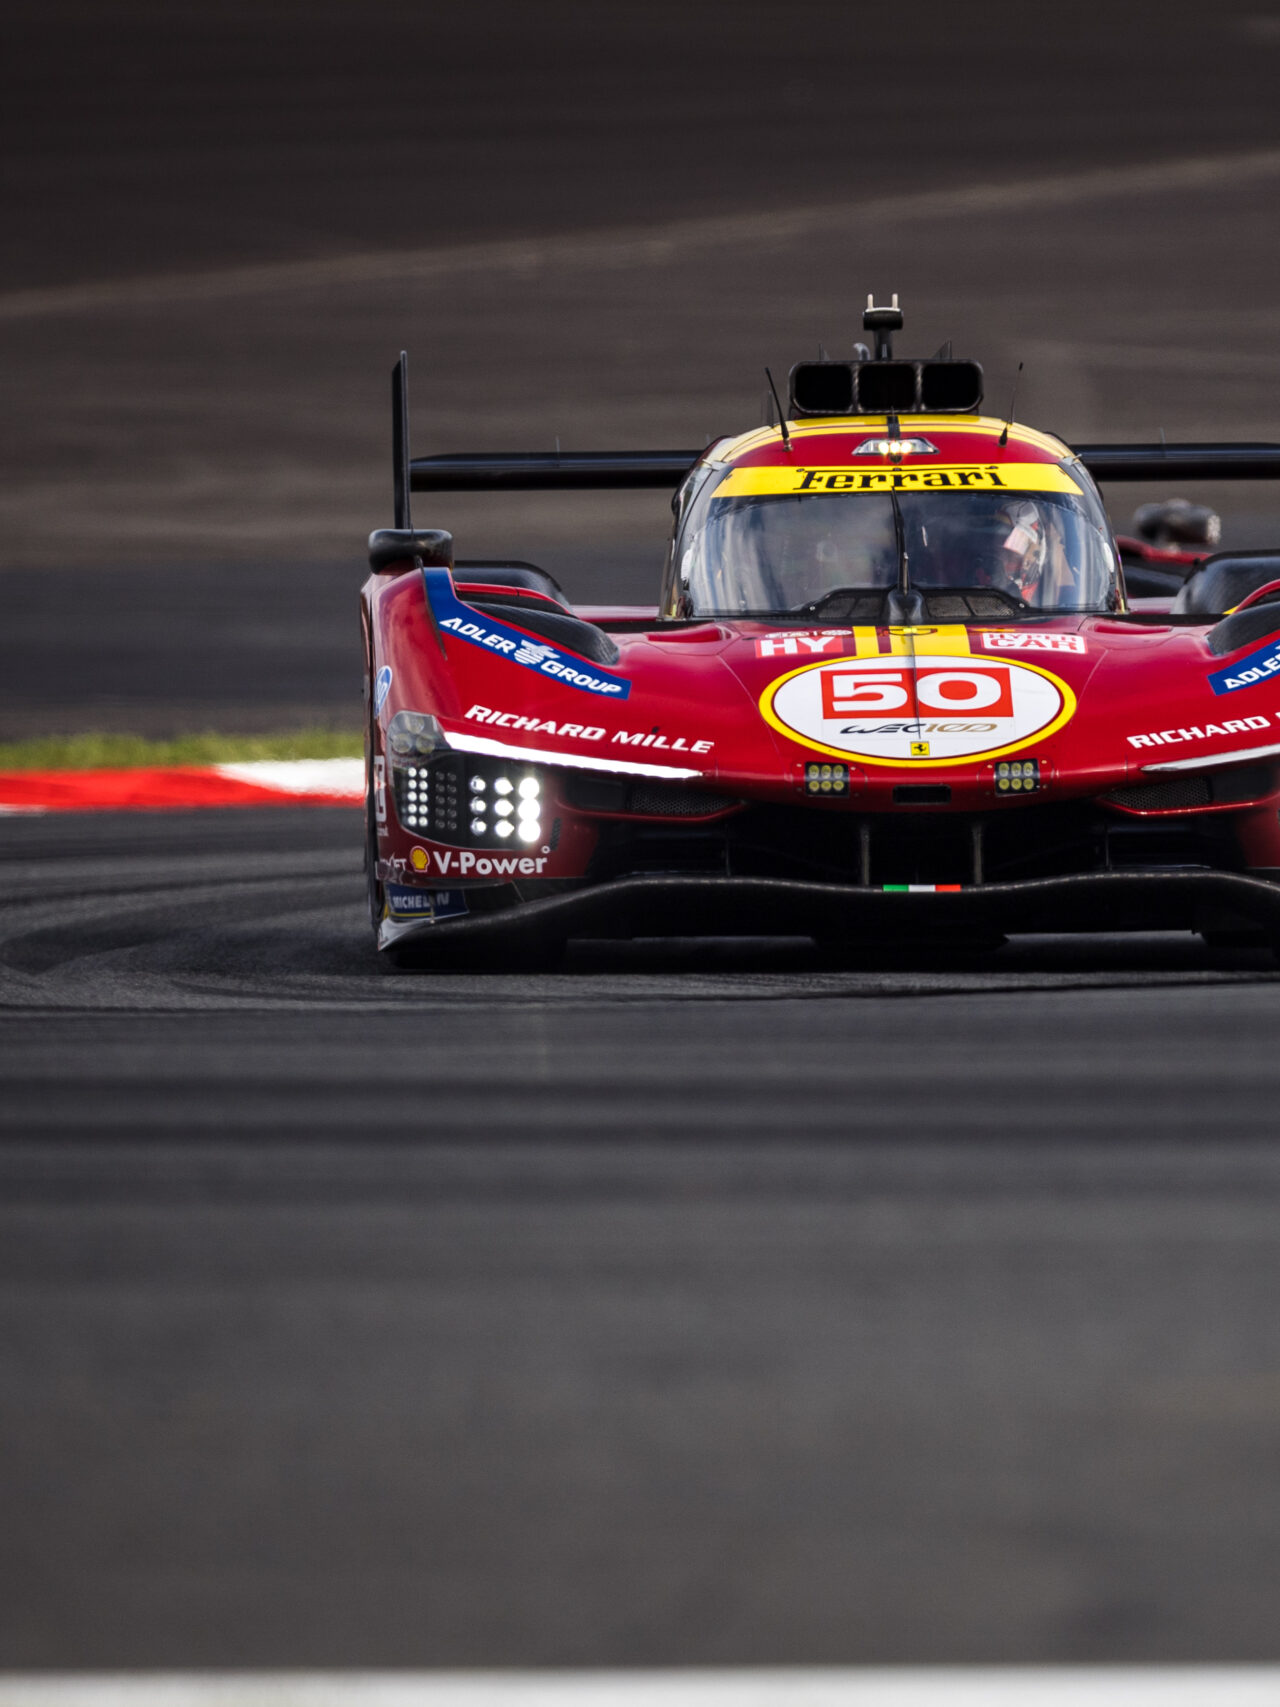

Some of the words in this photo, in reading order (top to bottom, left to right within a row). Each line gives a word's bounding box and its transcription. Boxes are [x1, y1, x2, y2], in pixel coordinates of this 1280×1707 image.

[793, 466, 1007, 491] Ferrari
[440, 617, 516, 653] ADLER
[541, 661, 622, 693] GROUP
[760, 636, 835, 656] HY
[990, 638, 1078, 650] CAR
[832, 672, 1002, 713] 50
[464, 705, 606, 740] RICHARD
[611, 730, 715, 753] MILLE
[1126, 716, 1271, 749] RICHARD
[433, 851, 548, 875] V-Power
[392, 891, 450, 909] MICHELN
